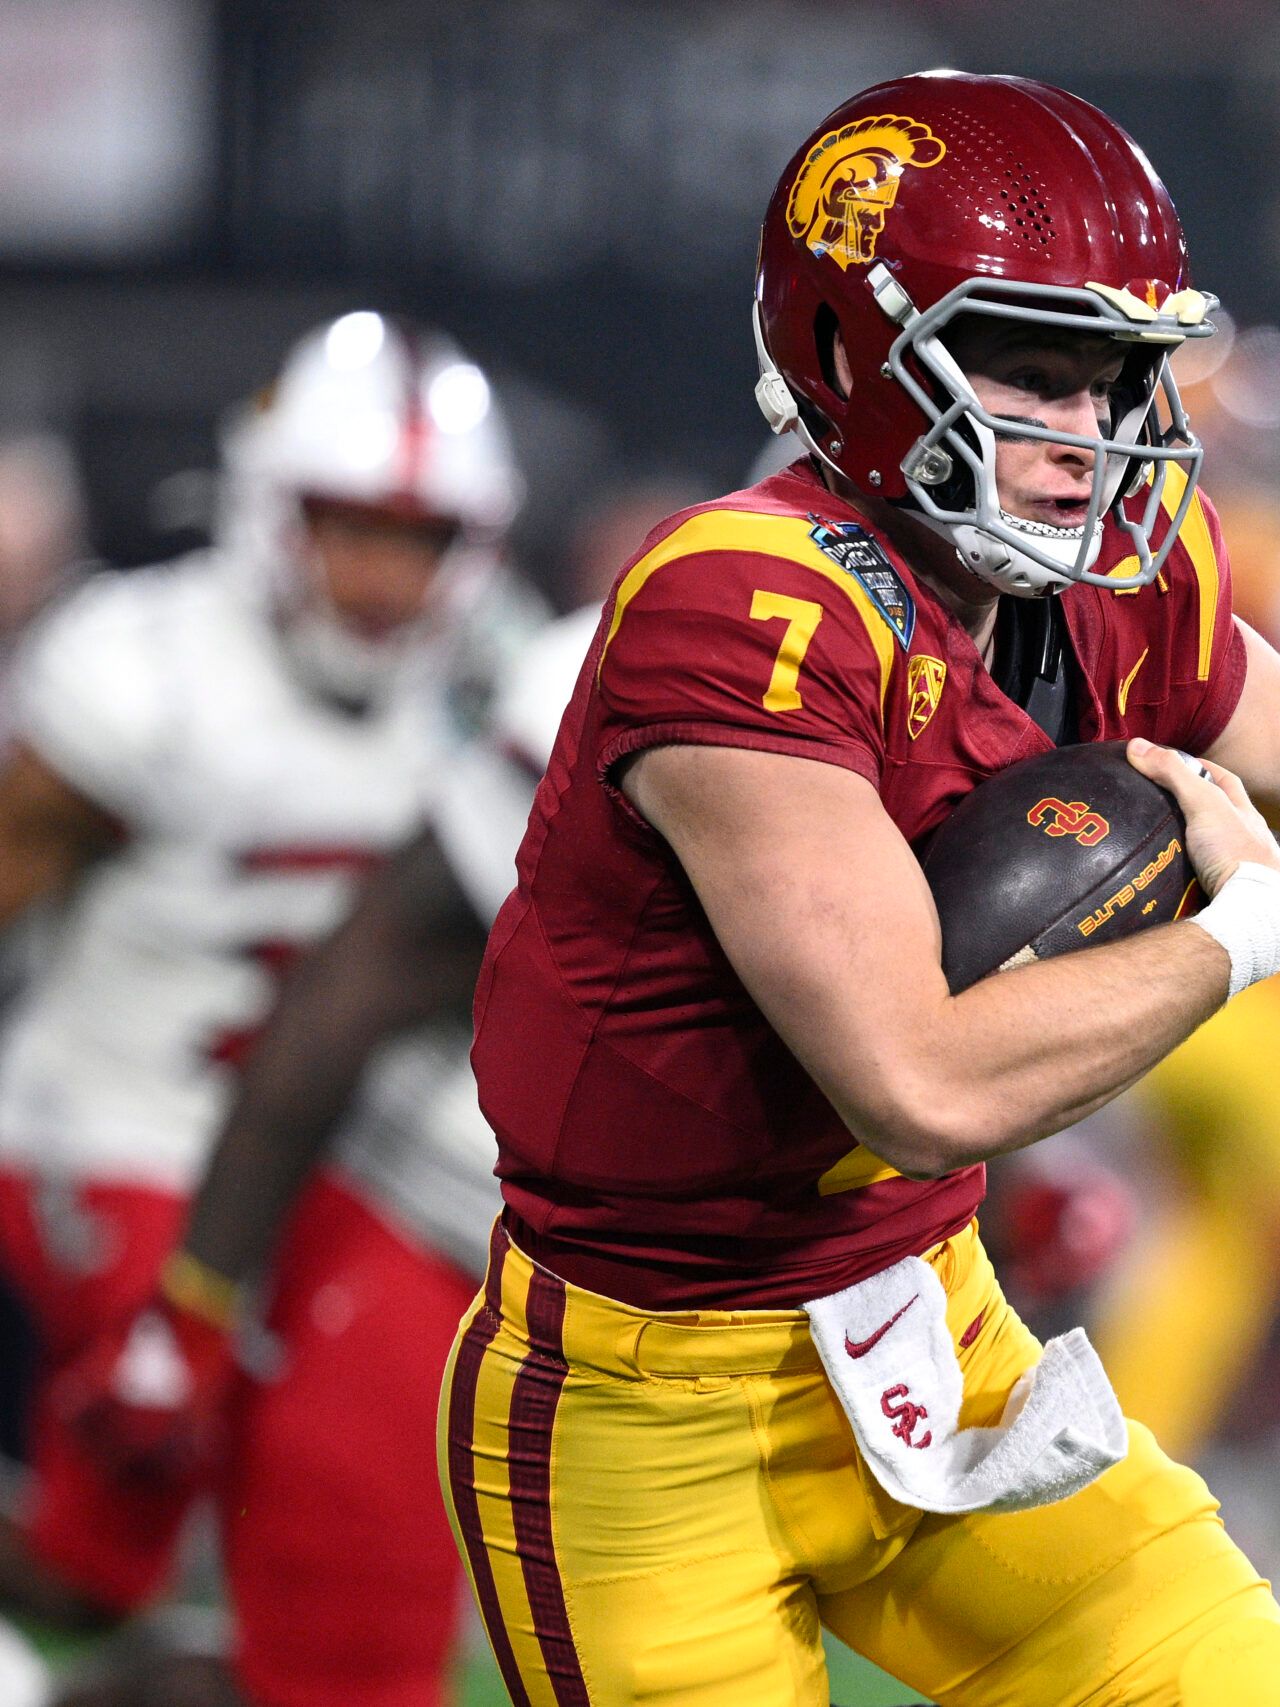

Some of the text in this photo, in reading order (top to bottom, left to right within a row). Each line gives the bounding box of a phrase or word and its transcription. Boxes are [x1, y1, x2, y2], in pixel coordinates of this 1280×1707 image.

[750, 591, 822, 712] 7
[1077, 838, 1182, 936] VAPOR ELITE
[880, 1383, 932, 1449] SC
